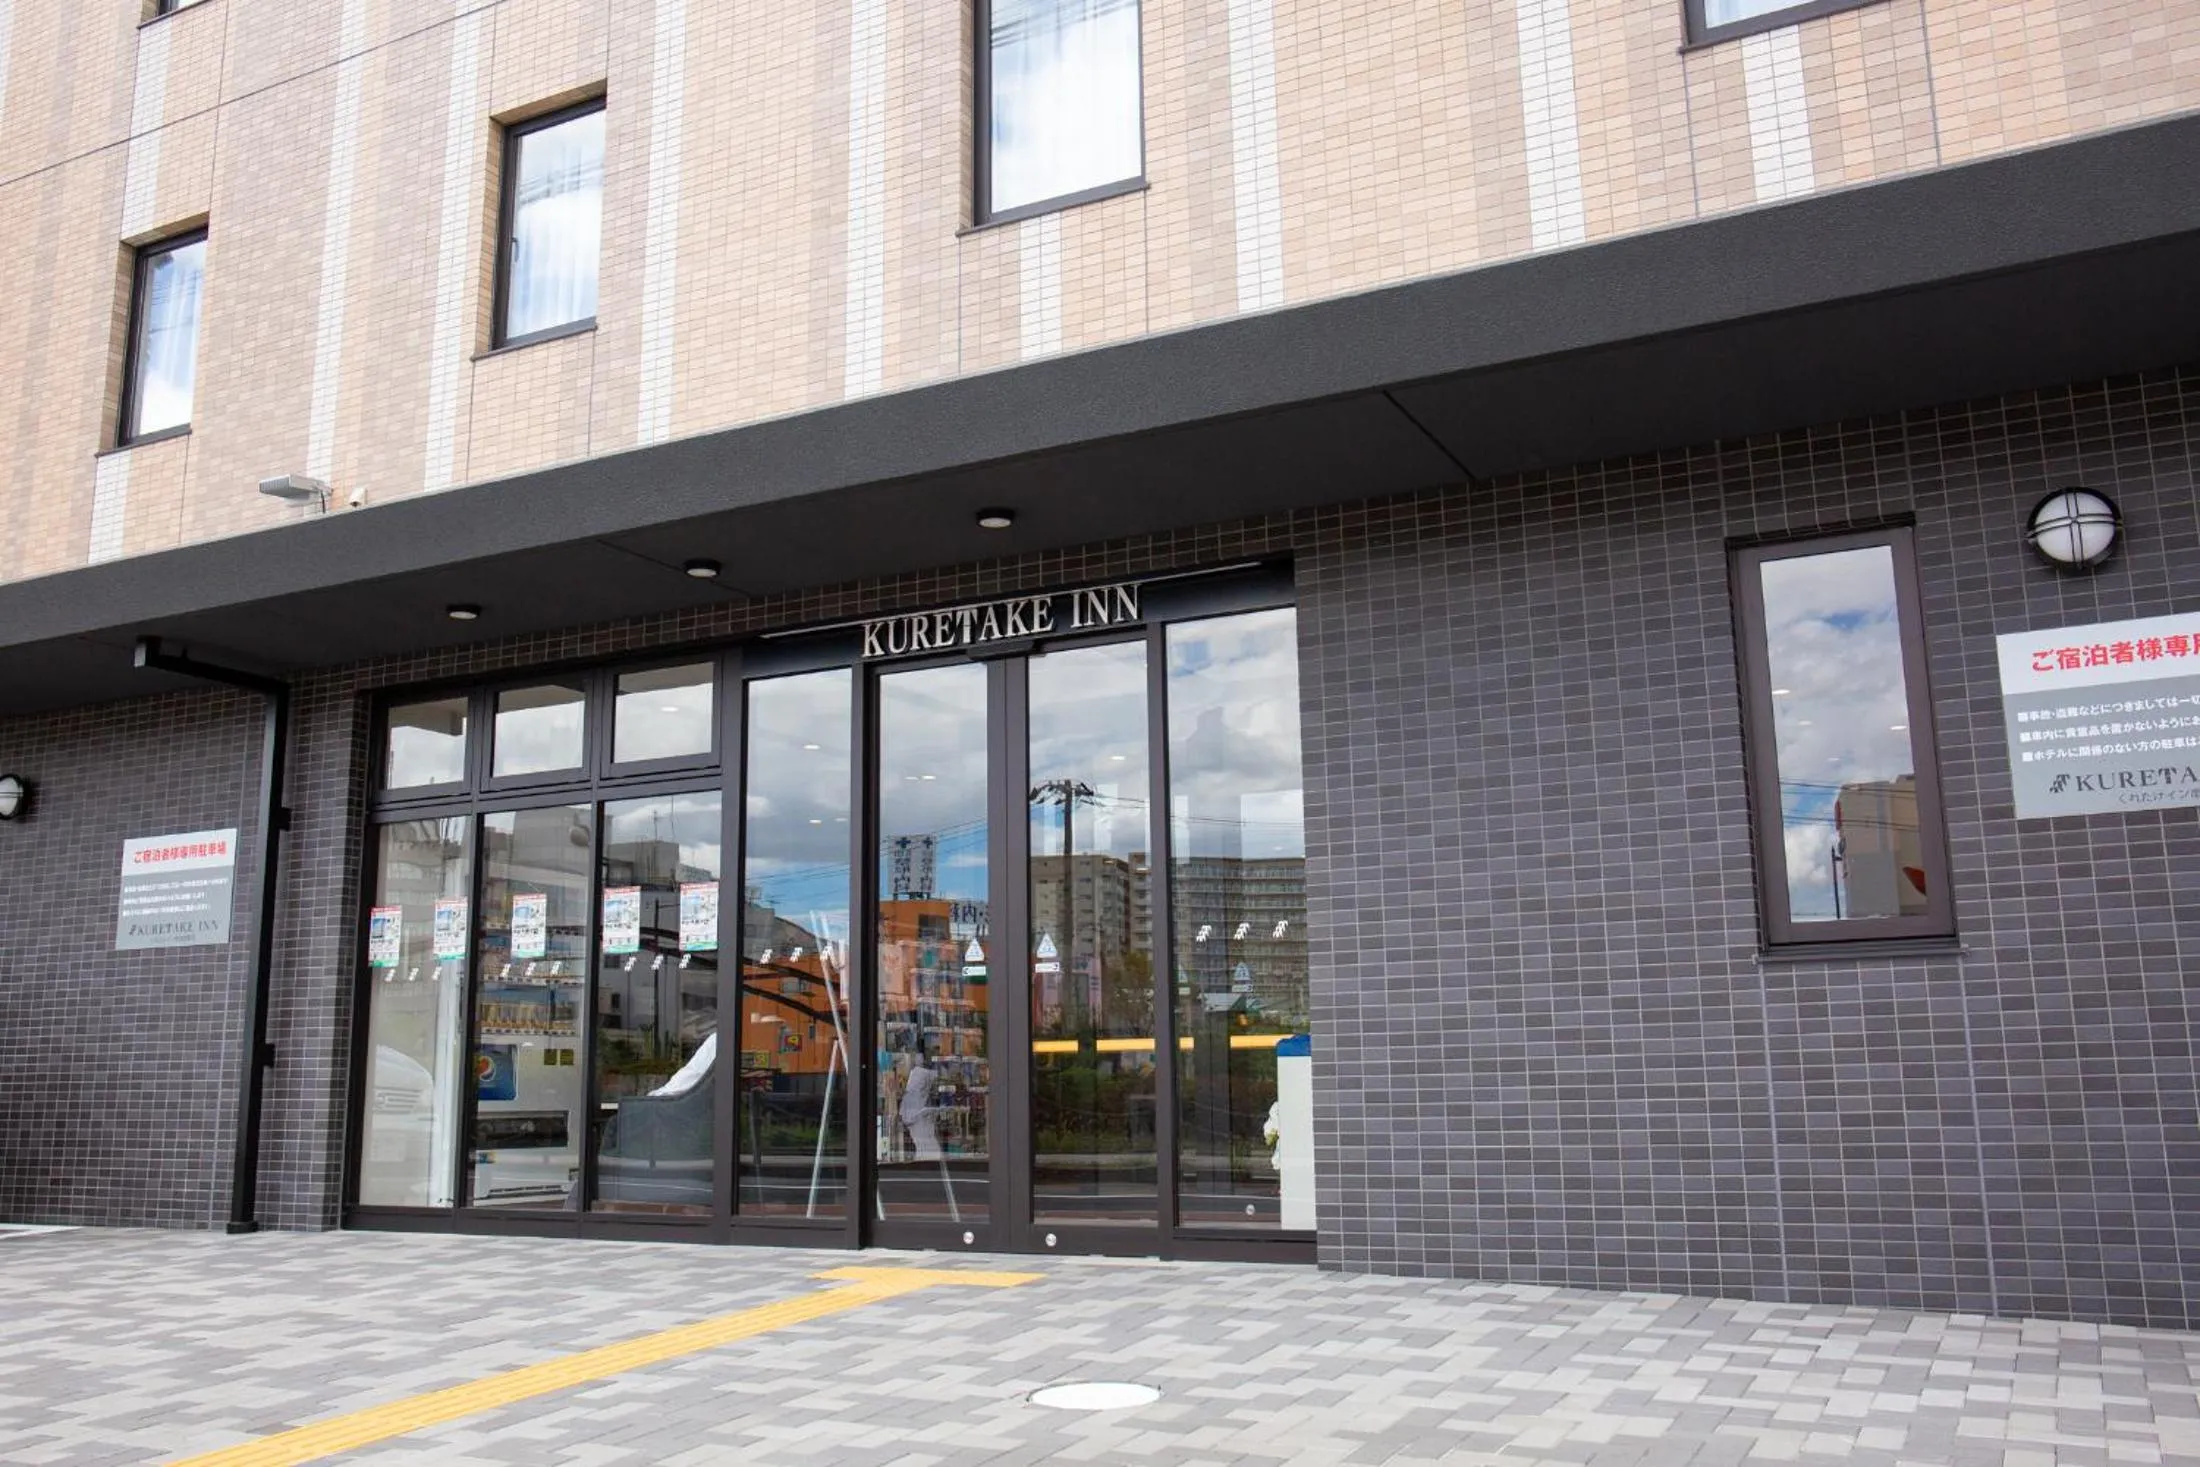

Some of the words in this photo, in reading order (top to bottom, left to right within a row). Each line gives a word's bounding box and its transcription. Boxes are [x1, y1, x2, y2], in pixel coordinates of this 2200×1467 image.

[862, 598, 1055, 658] KURETAKE
[1070, 583, 1142, 629] INN
[2032, 633, 2200, 671] ご宿泊者様専
[2034, 735, 2200, 761] ホテルに関係のない方の駐車は
